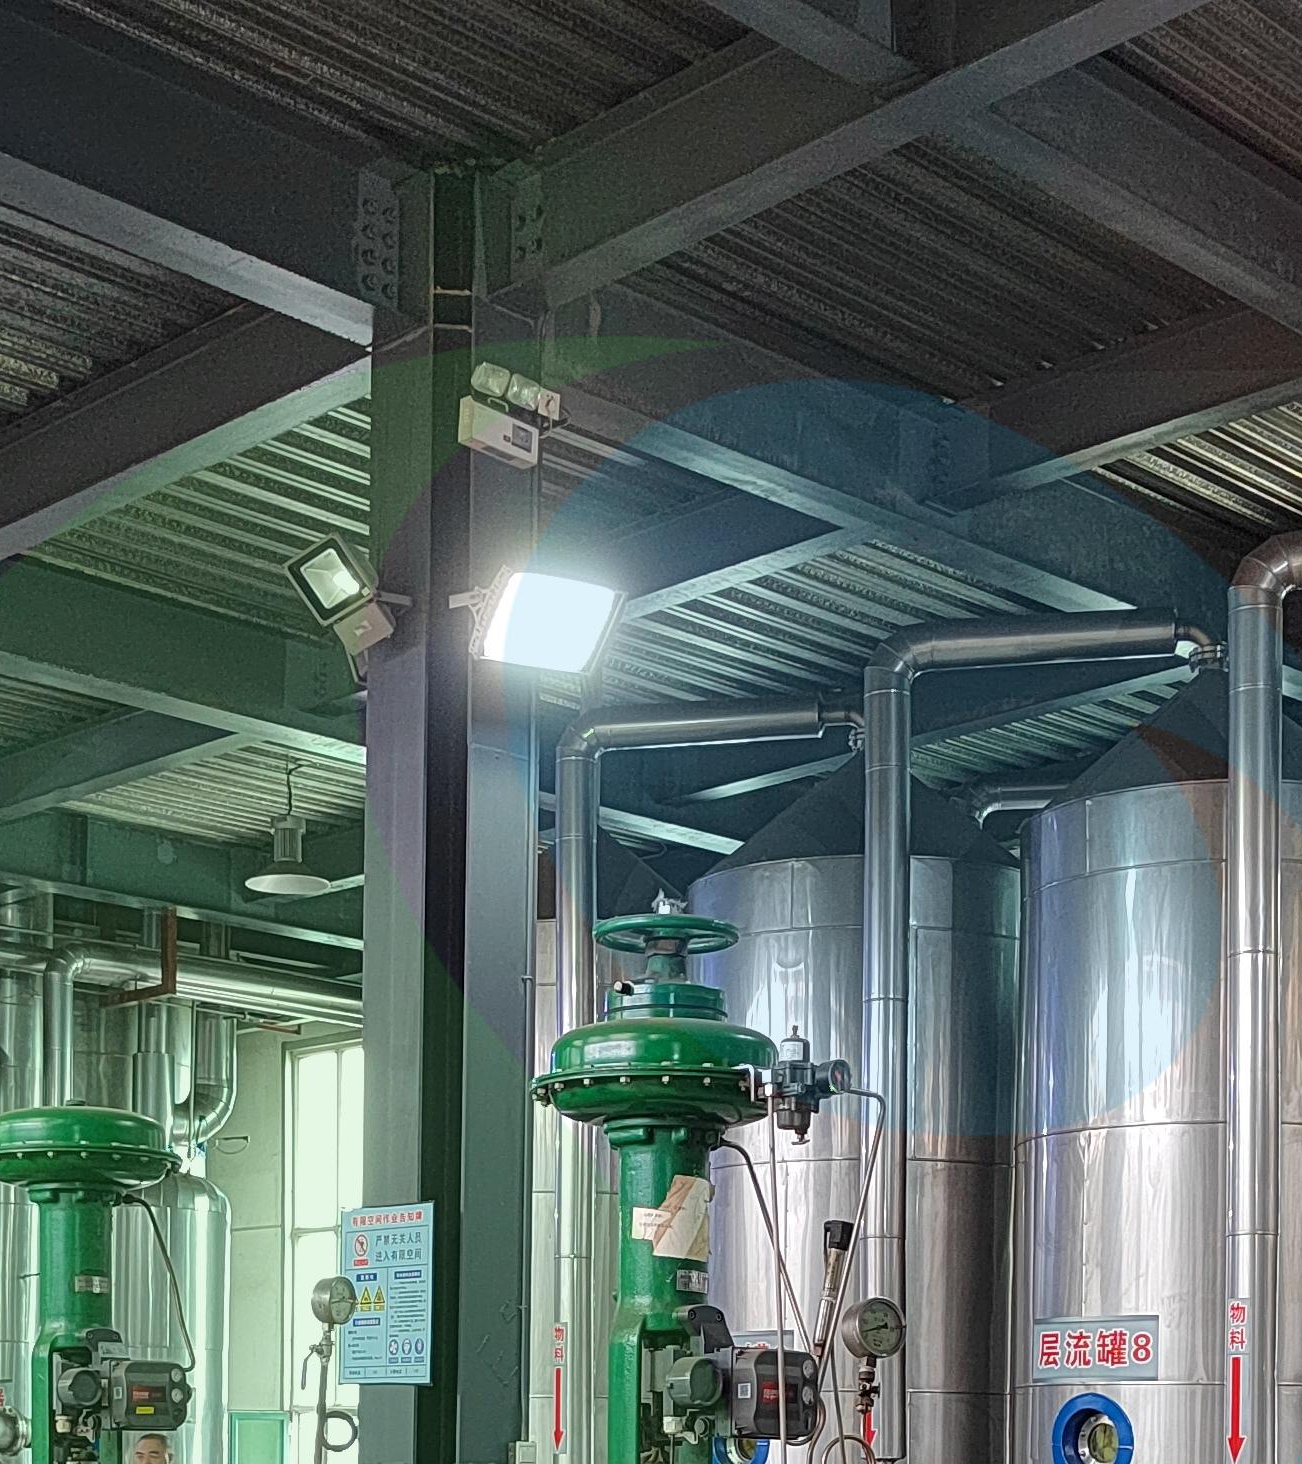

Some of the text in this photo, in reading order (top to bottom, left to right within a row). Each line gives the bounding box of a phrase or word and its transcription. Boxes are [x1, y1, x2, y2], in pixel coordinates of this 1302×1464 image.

[352, 1211, 422, 1227] 有限空间作业告知牌
[375, 1231, 421, 1246] 严禁无关人员
[375, 1248, 421, 1262] 进入有限空间
[1230, 1303, 1246, 1349] 物料
[1039, 1331, 1151, 1367] 层流罐8
